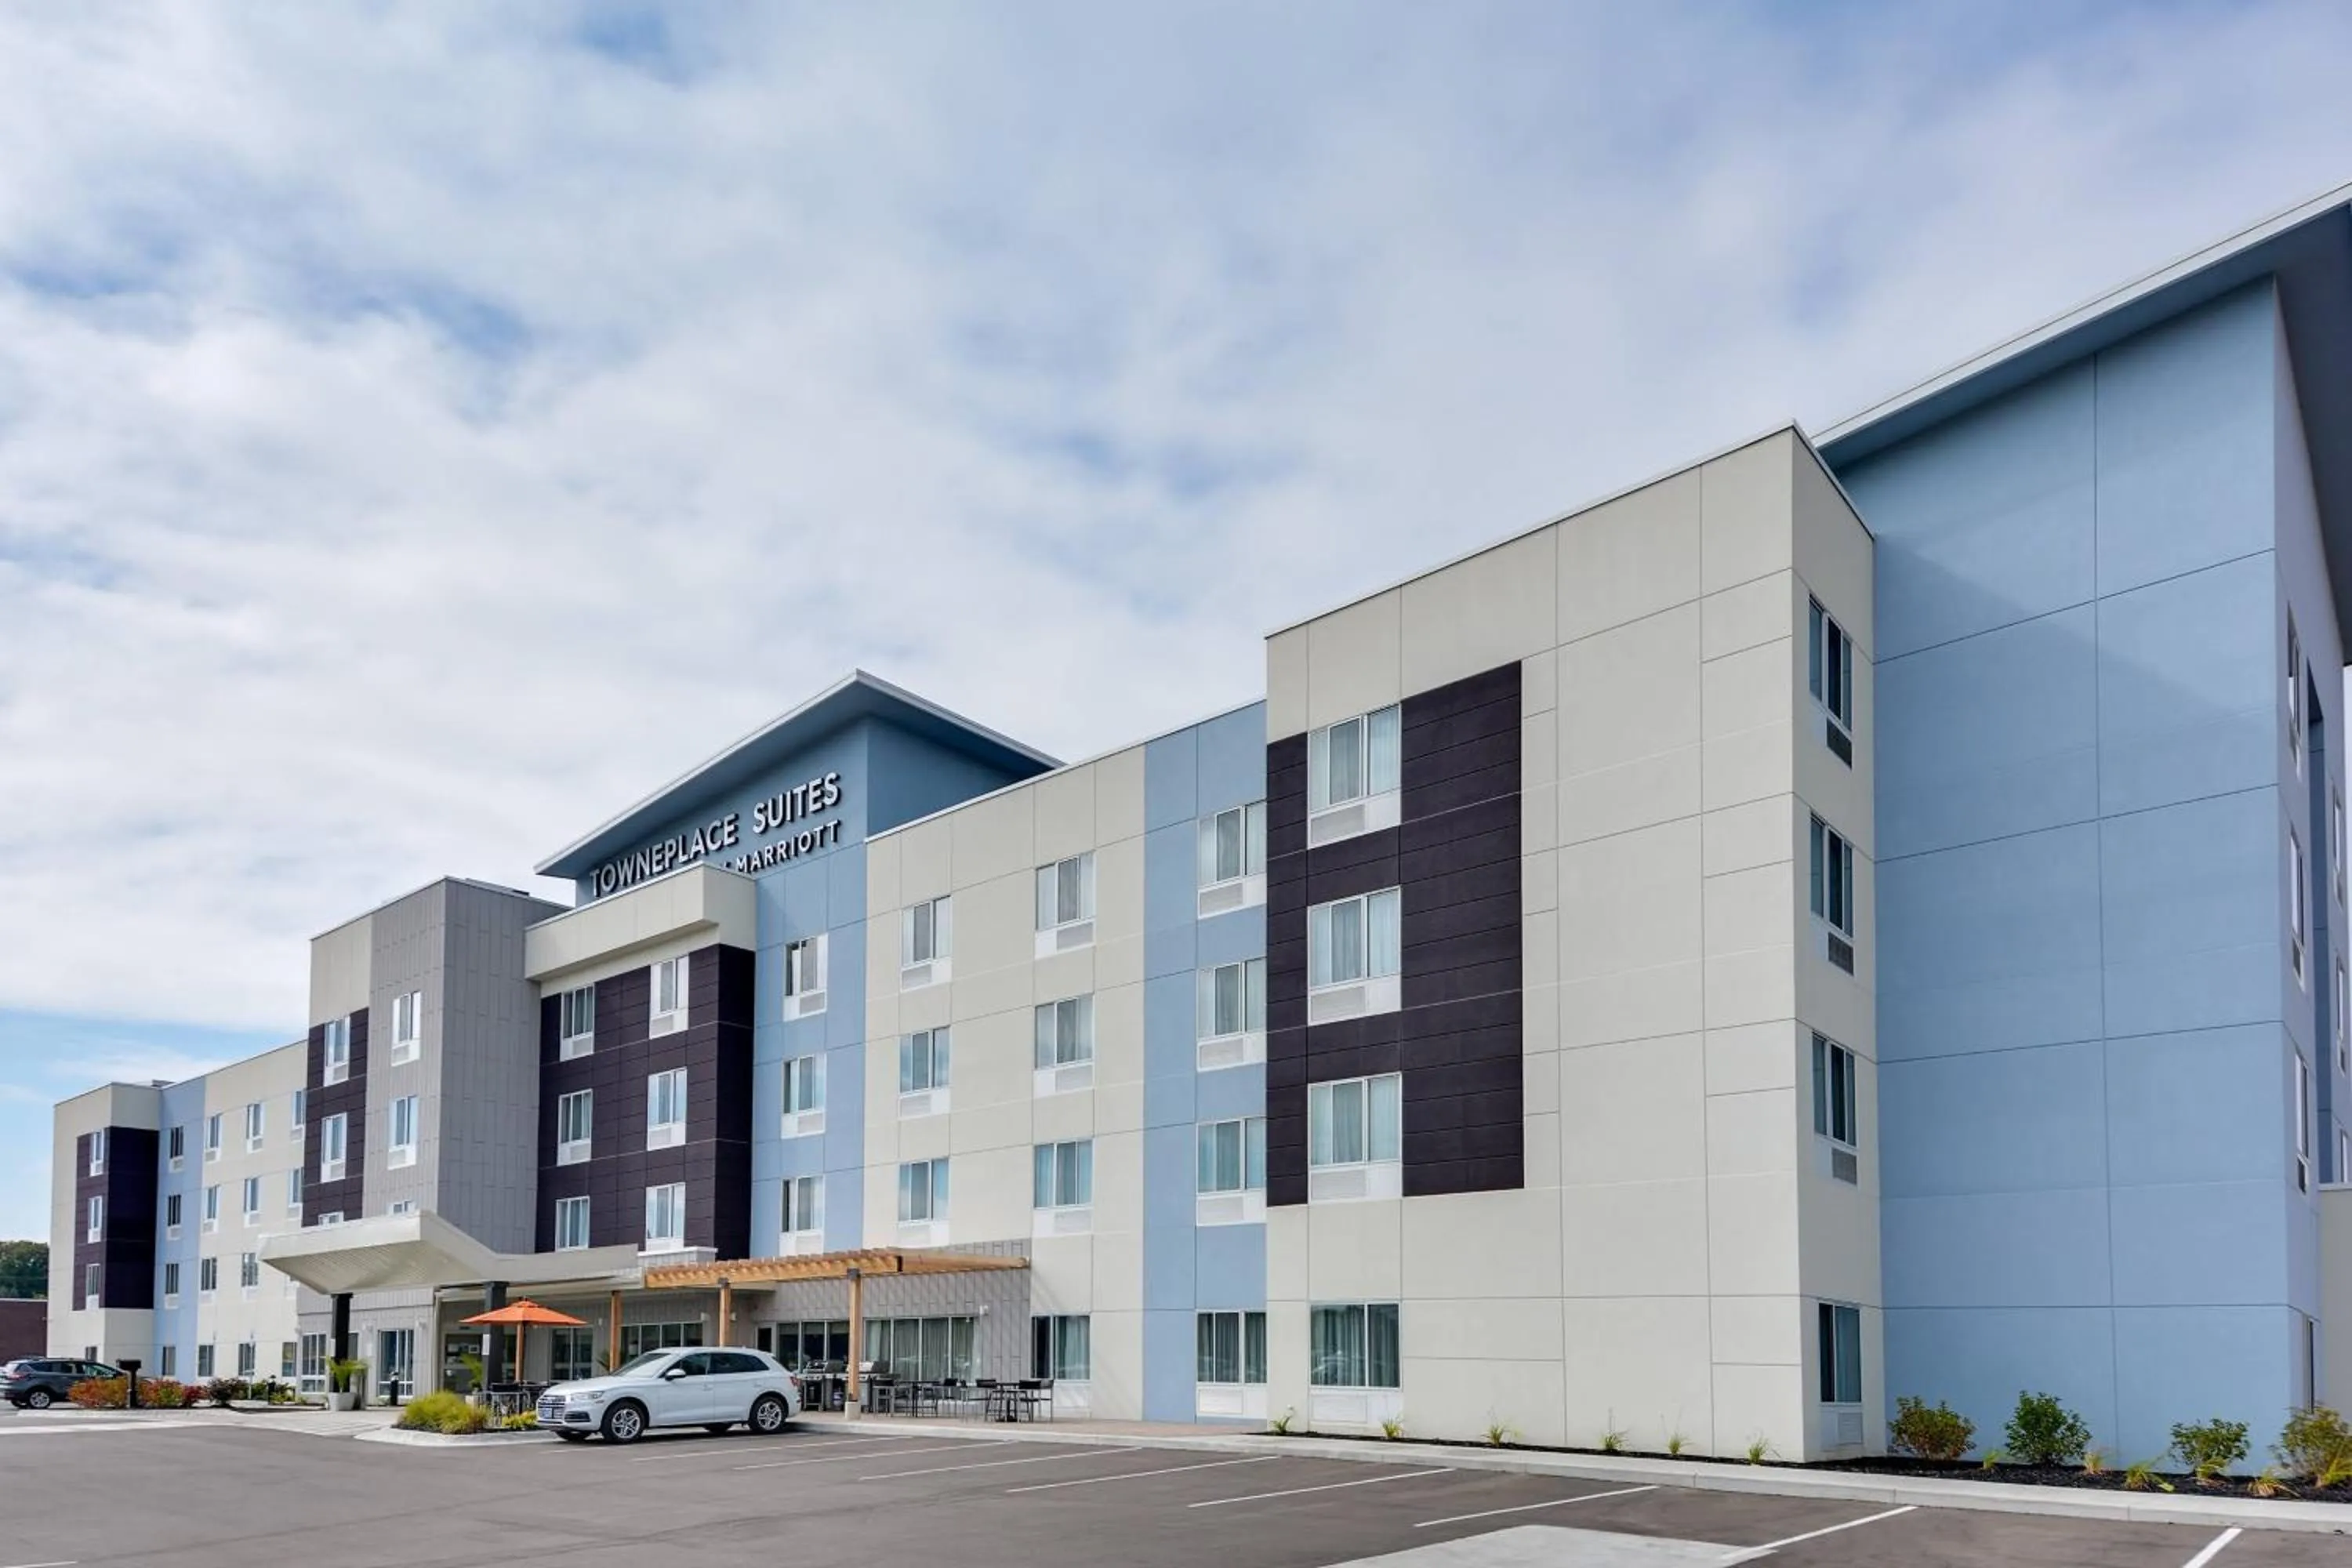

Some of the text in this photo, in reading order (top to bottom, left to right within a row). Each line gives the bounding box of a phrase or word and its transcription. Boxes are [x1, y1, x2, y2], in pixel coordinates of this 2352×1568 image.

[590, 771, 840, 897] TOWNEPLACE SUITES
[735, 819, 840, 873] MARRIOTT
